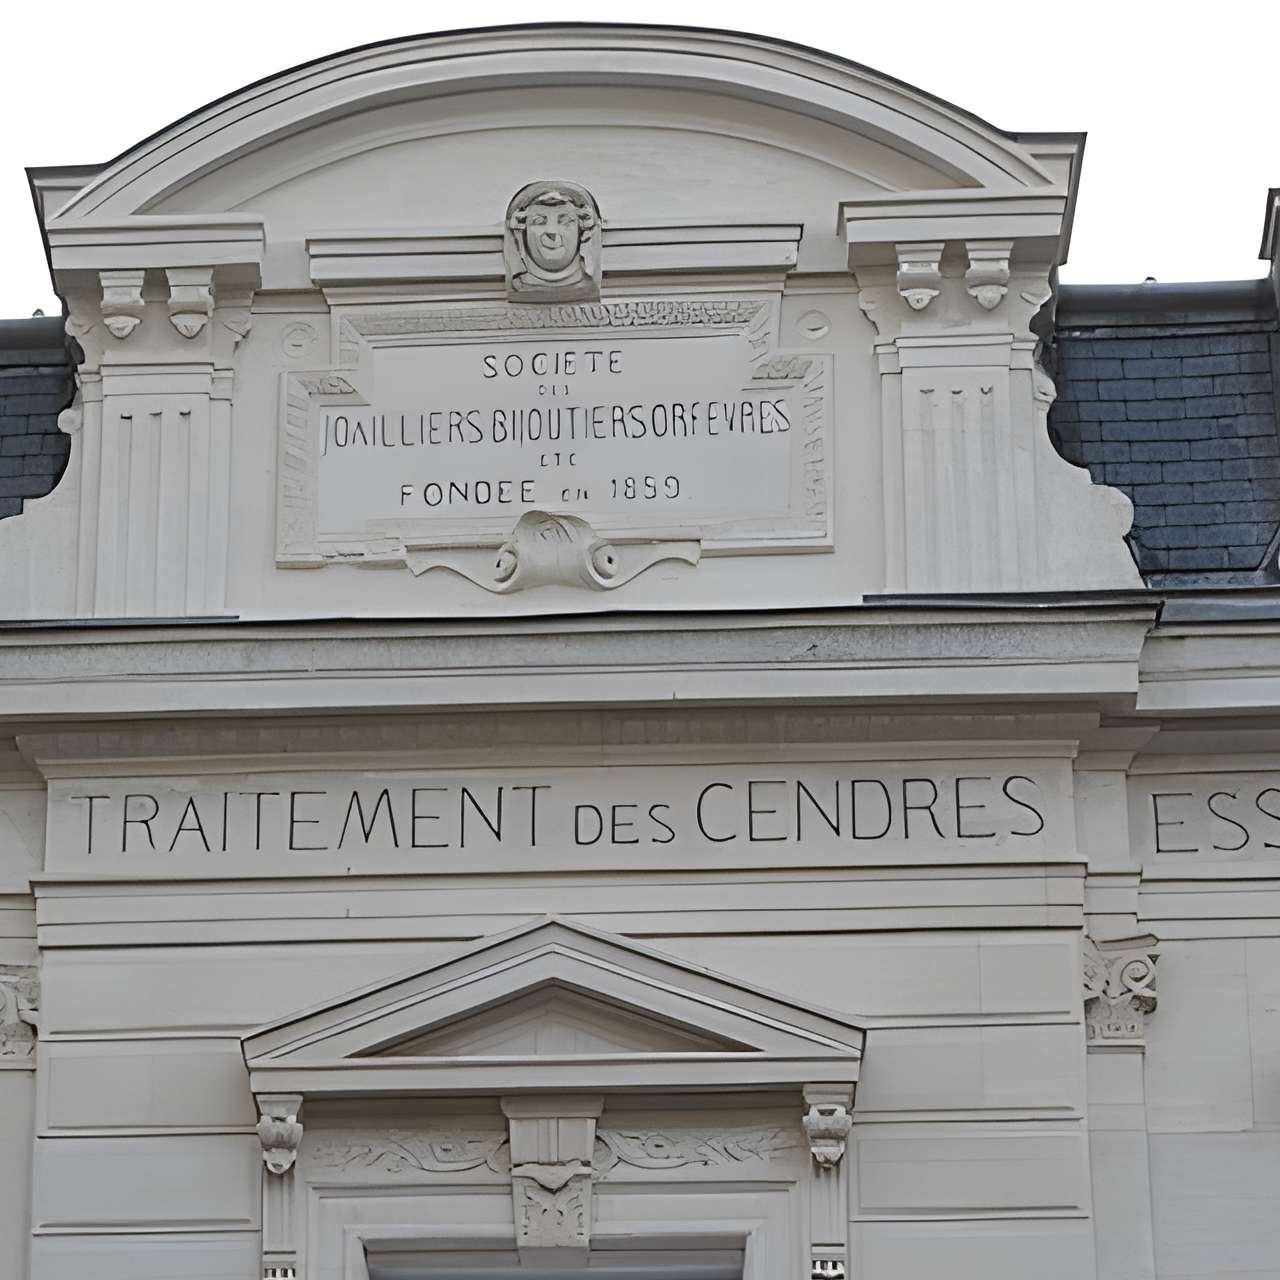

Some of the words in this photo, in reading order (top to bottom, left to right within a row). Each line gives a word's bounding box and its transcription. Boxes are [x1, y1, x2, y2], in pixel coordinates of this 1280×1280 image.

[71, 785, 551, 855] TRAITEMENT
[575, 804, 676, 846] DES
[697, 775, 1045, 843] CENDRES
